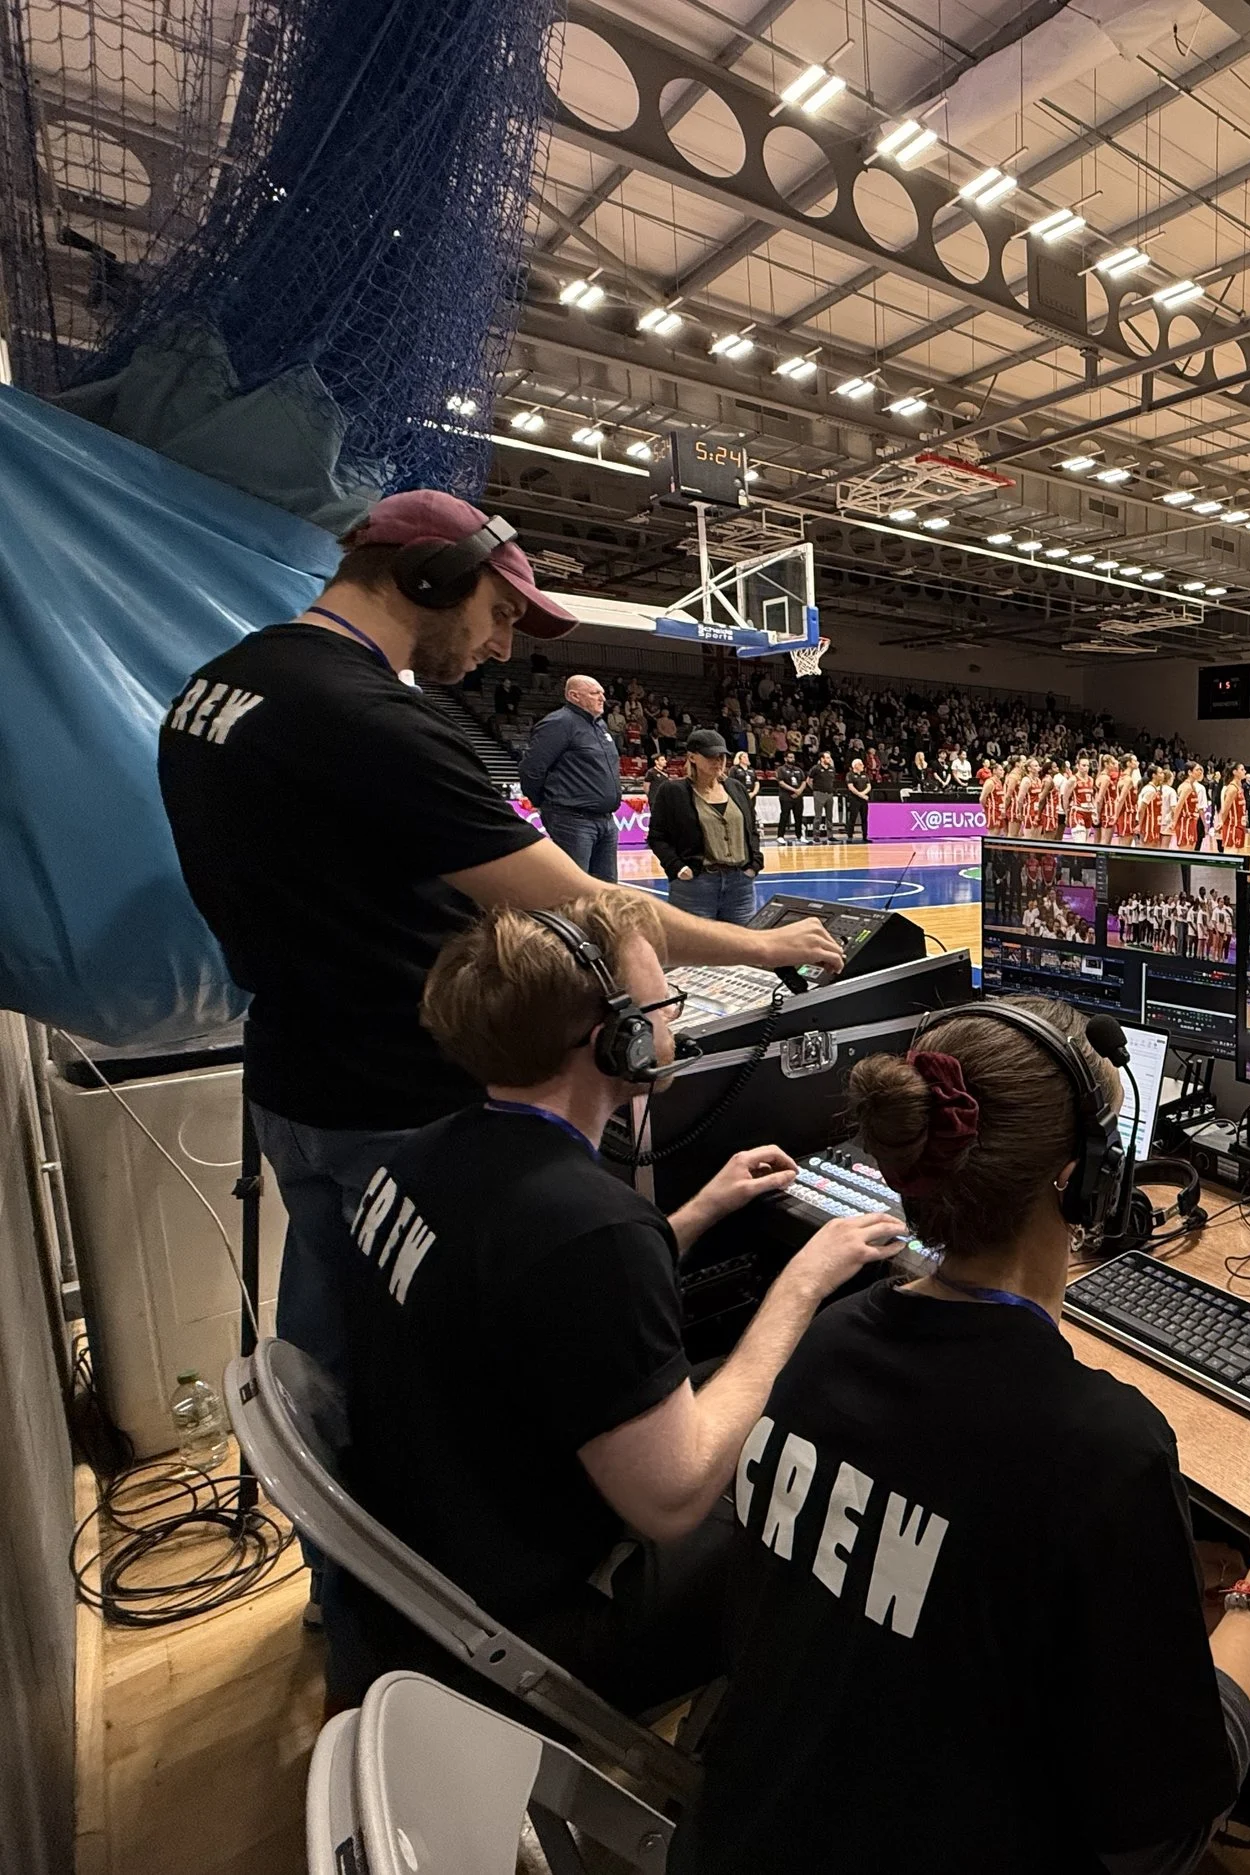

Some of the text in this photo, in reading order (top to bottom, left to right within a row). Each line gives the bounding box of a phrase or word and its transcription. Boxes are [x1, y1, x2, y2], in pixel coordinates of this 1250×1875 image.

[695, 441, 743, 468] 5:24
[168, 678, 264, 744] REW
[350, 1166, 437, 1306] CREW
[735, 1415, 949, 1639] CREW
